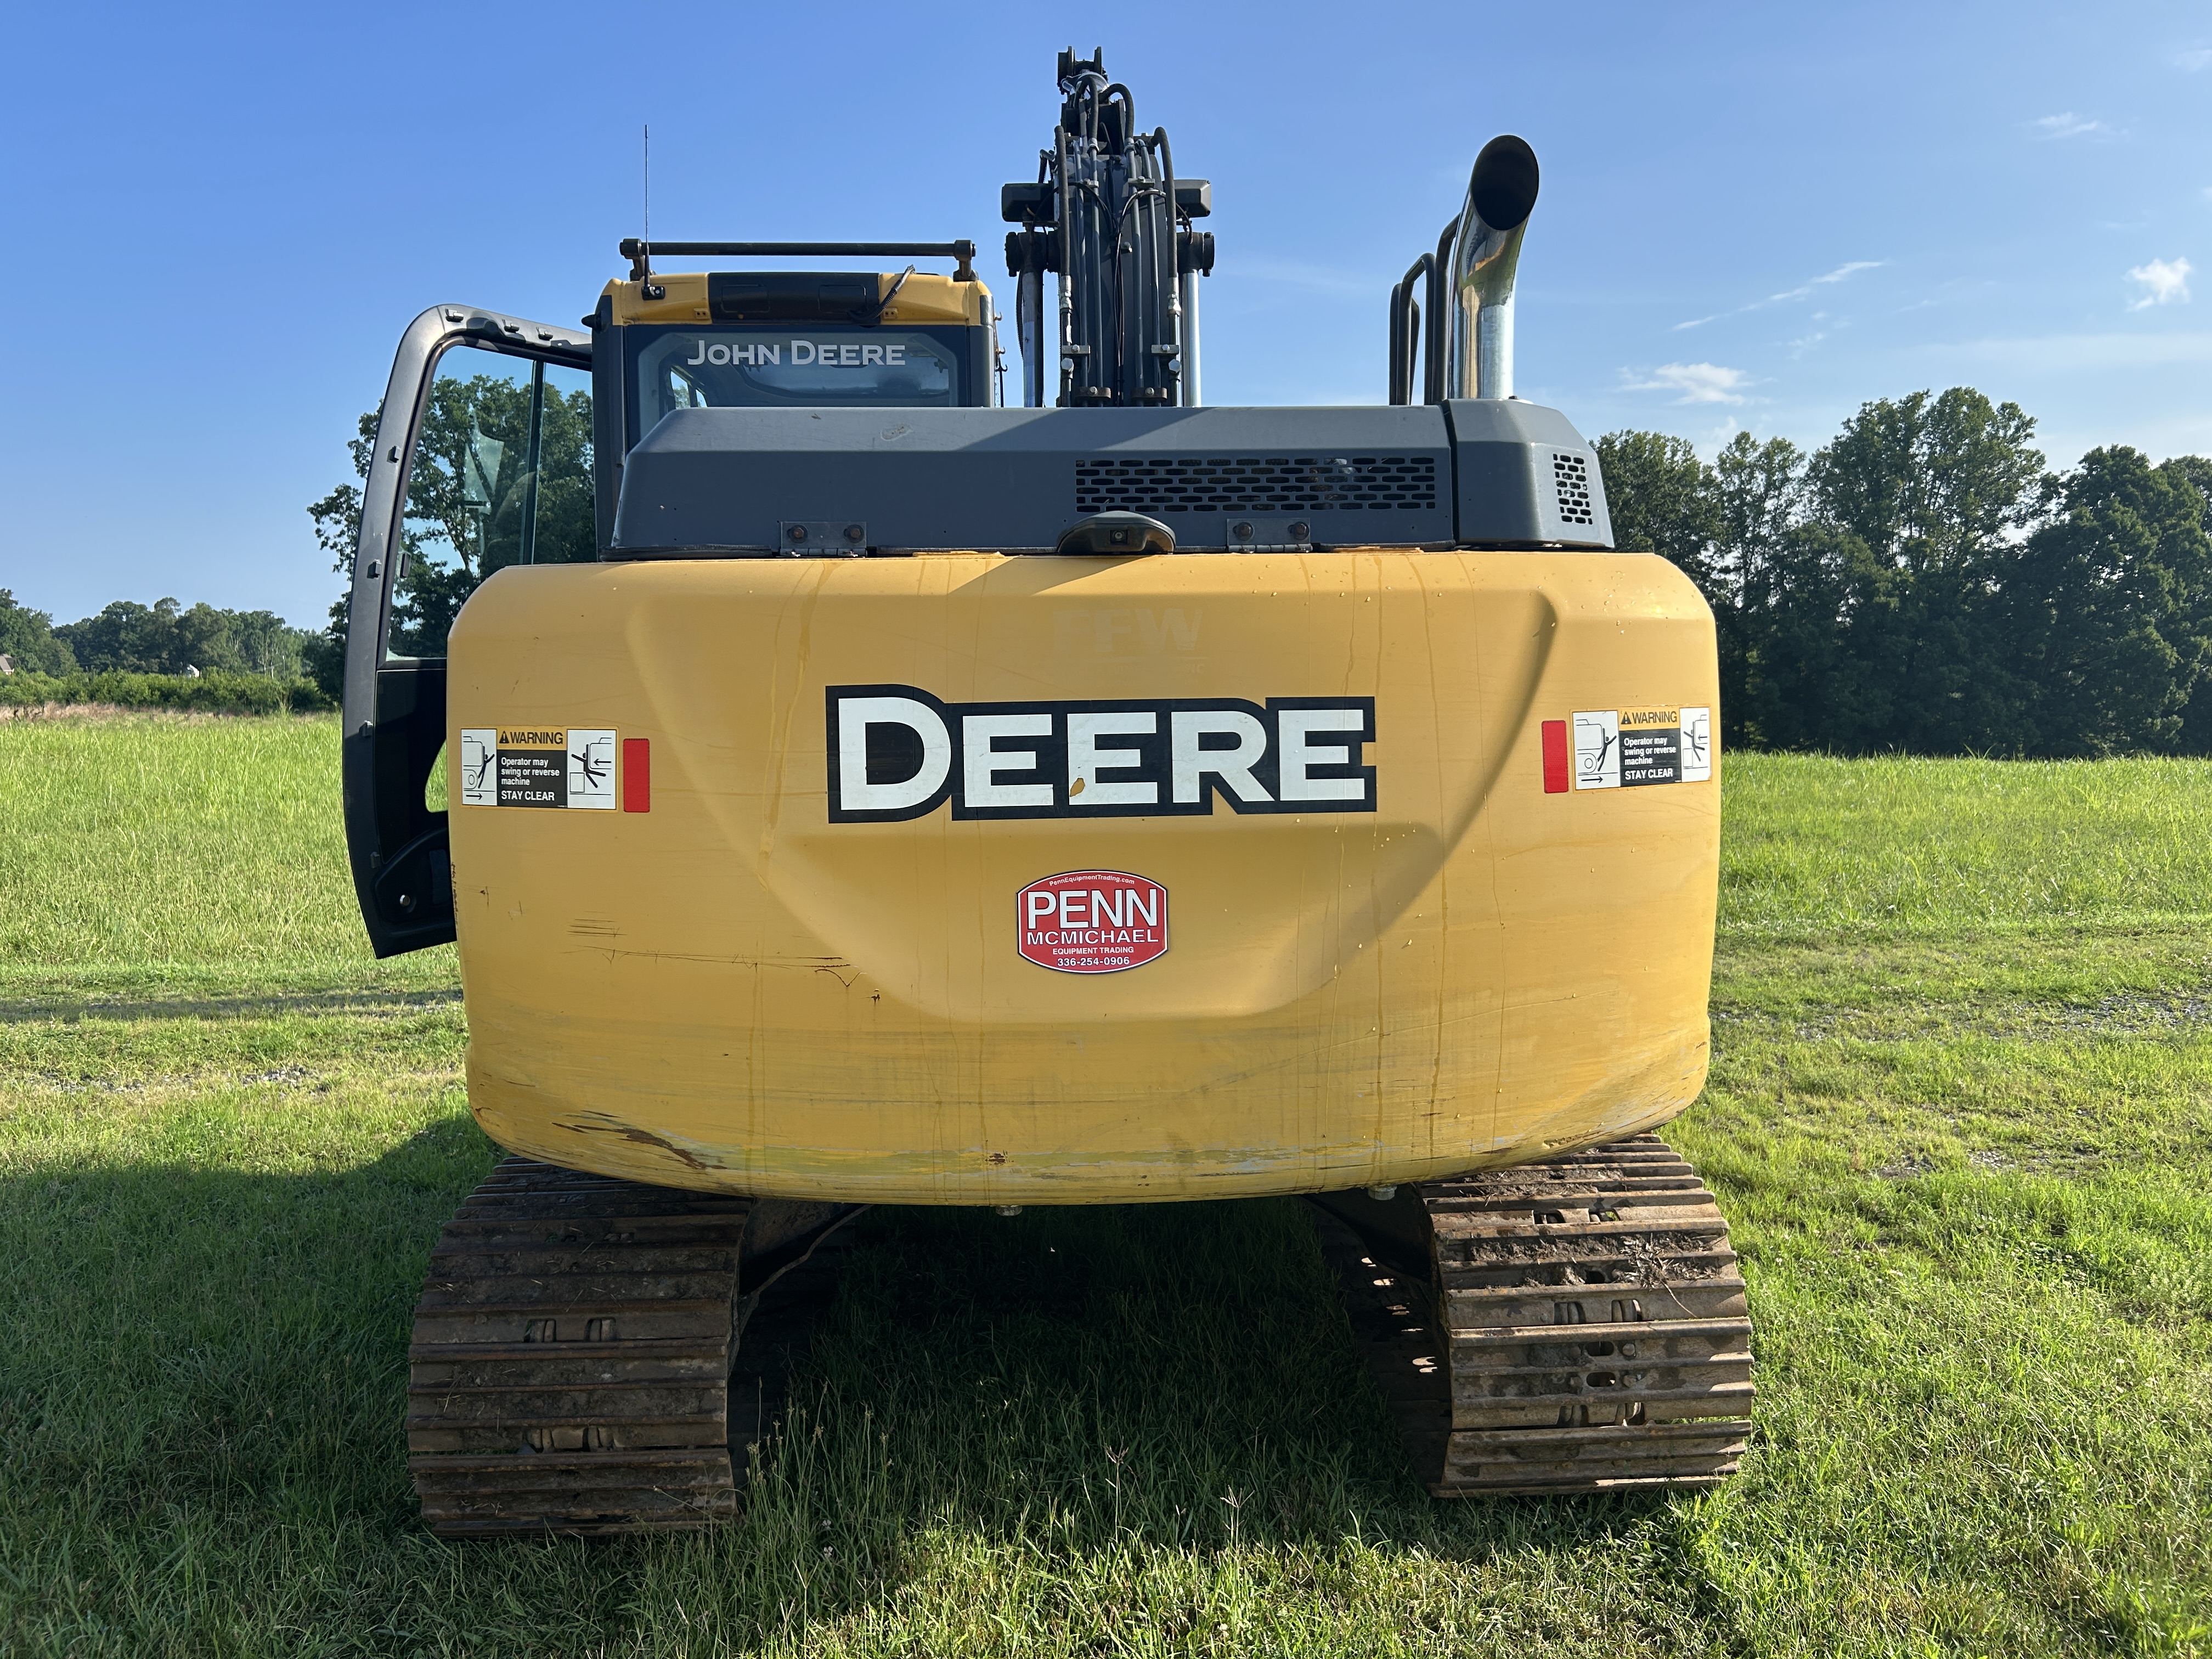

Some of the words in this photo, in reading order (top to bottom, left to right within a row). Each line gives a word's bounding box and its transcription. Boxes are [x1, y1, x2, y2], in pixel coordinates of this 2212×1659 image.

[687, 340, 780, 365] JOHN
[791, 340, 906, 365] DEERE
[1632, 711, 1678, 724] WARNING
[510, 731, 563, 744] WARNING
[1623, 737, 1654, 747] Operator
[1654, 737, 1667, 745] may
[838, 697, 1365, 811] DEERE
[1624, 747, 1644, 757] swing
[1654, 746, 1677, 754] reverse
[500, 757, 531, 767] Operator
[532, 758, 549, 768] may
[1624, 756, 1653, 765] machine
[500, 768, 522, 777] swing
[532, 769, 560, 777] reverse
[1624, 770, 1647, 780] STAY
[1647, 768, 1673, 779] CLEAR
[500, 777, 530, 786] machine
[500, 791, 523, 800] STAY
[524, 791, 555, 802] CLEAR
[1049, 874, 1135, 887] PennEquipmentTrading.com
[1027, 888, 1158, 929] PENN
[1026, 929, 1159, 945] MCMICHAEL
[1057, 956, 1130, 967] 336-254-0906
